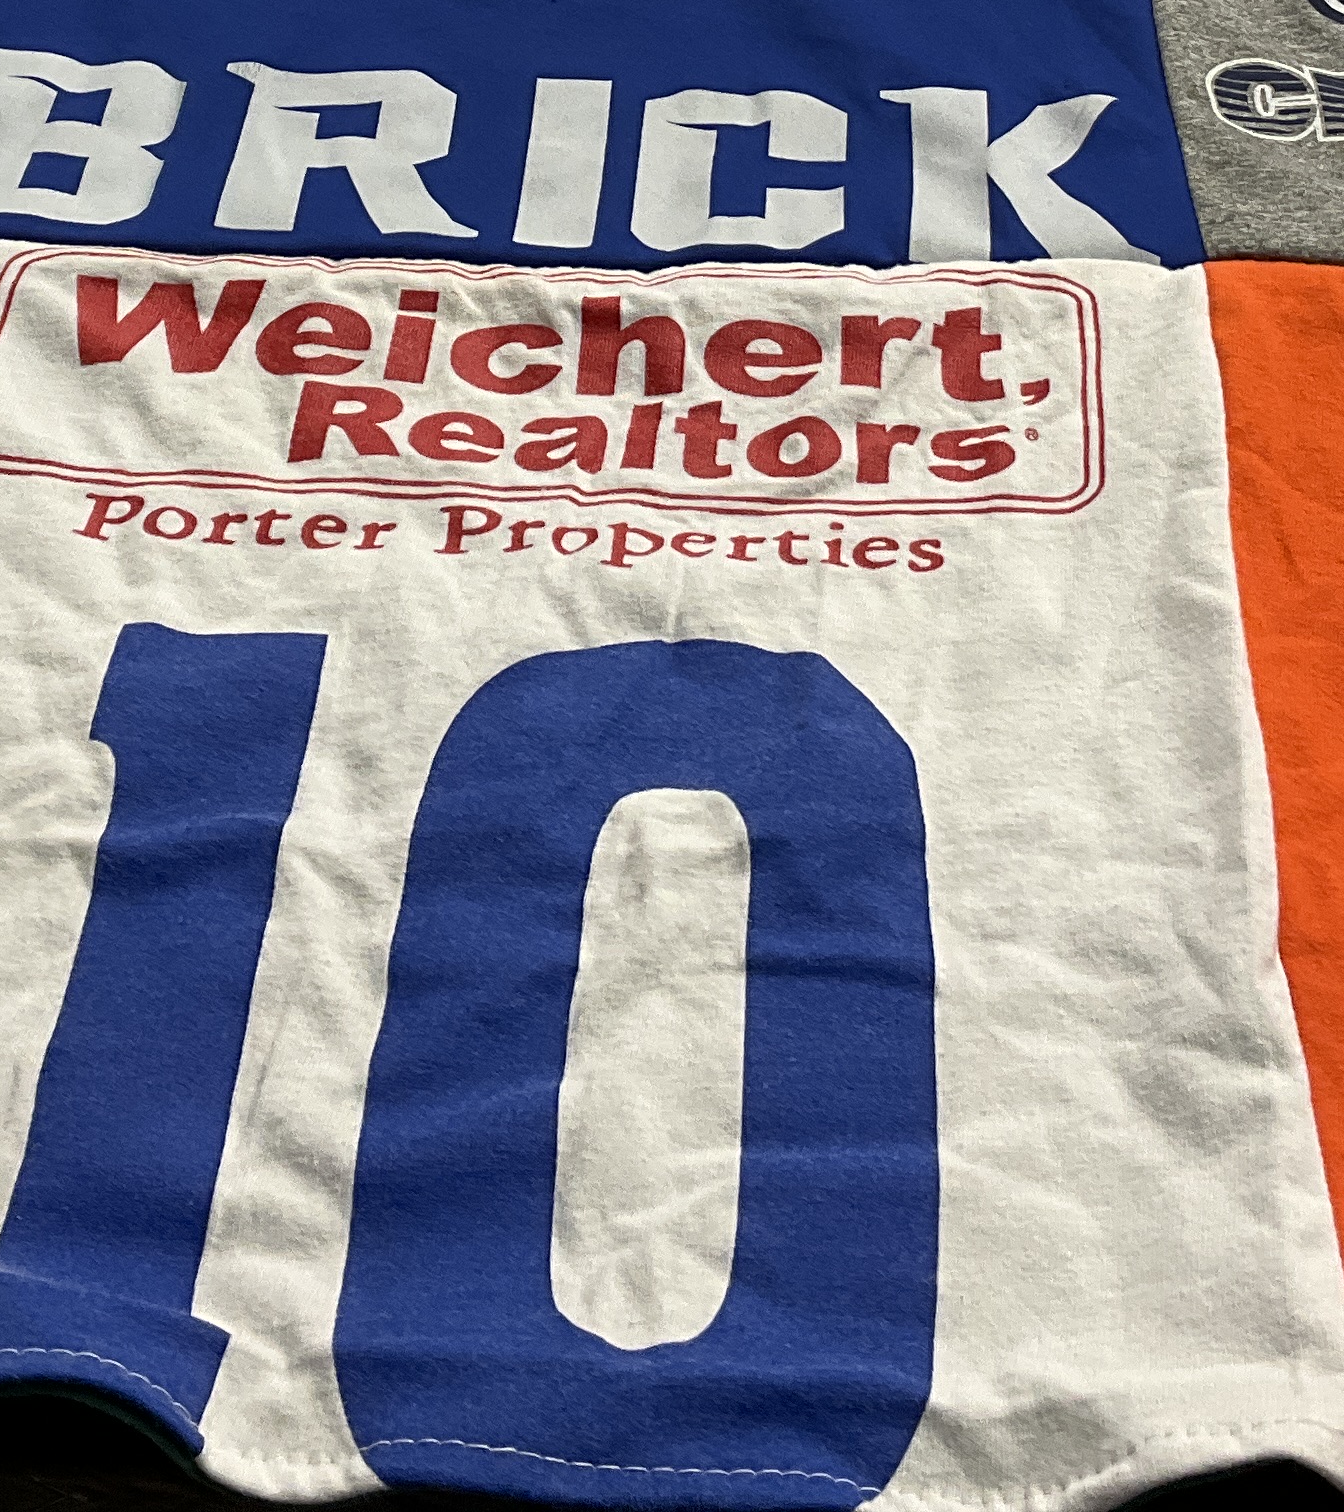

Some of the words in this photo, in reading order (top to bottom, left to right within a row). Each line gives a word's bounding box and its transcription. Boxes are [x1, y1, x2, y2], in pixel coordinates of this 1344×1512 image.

[75, 273, 1055, 409] Weichert,
[71, 491, 400, 555] Porter
[437, 504, 947, 575] Properties
